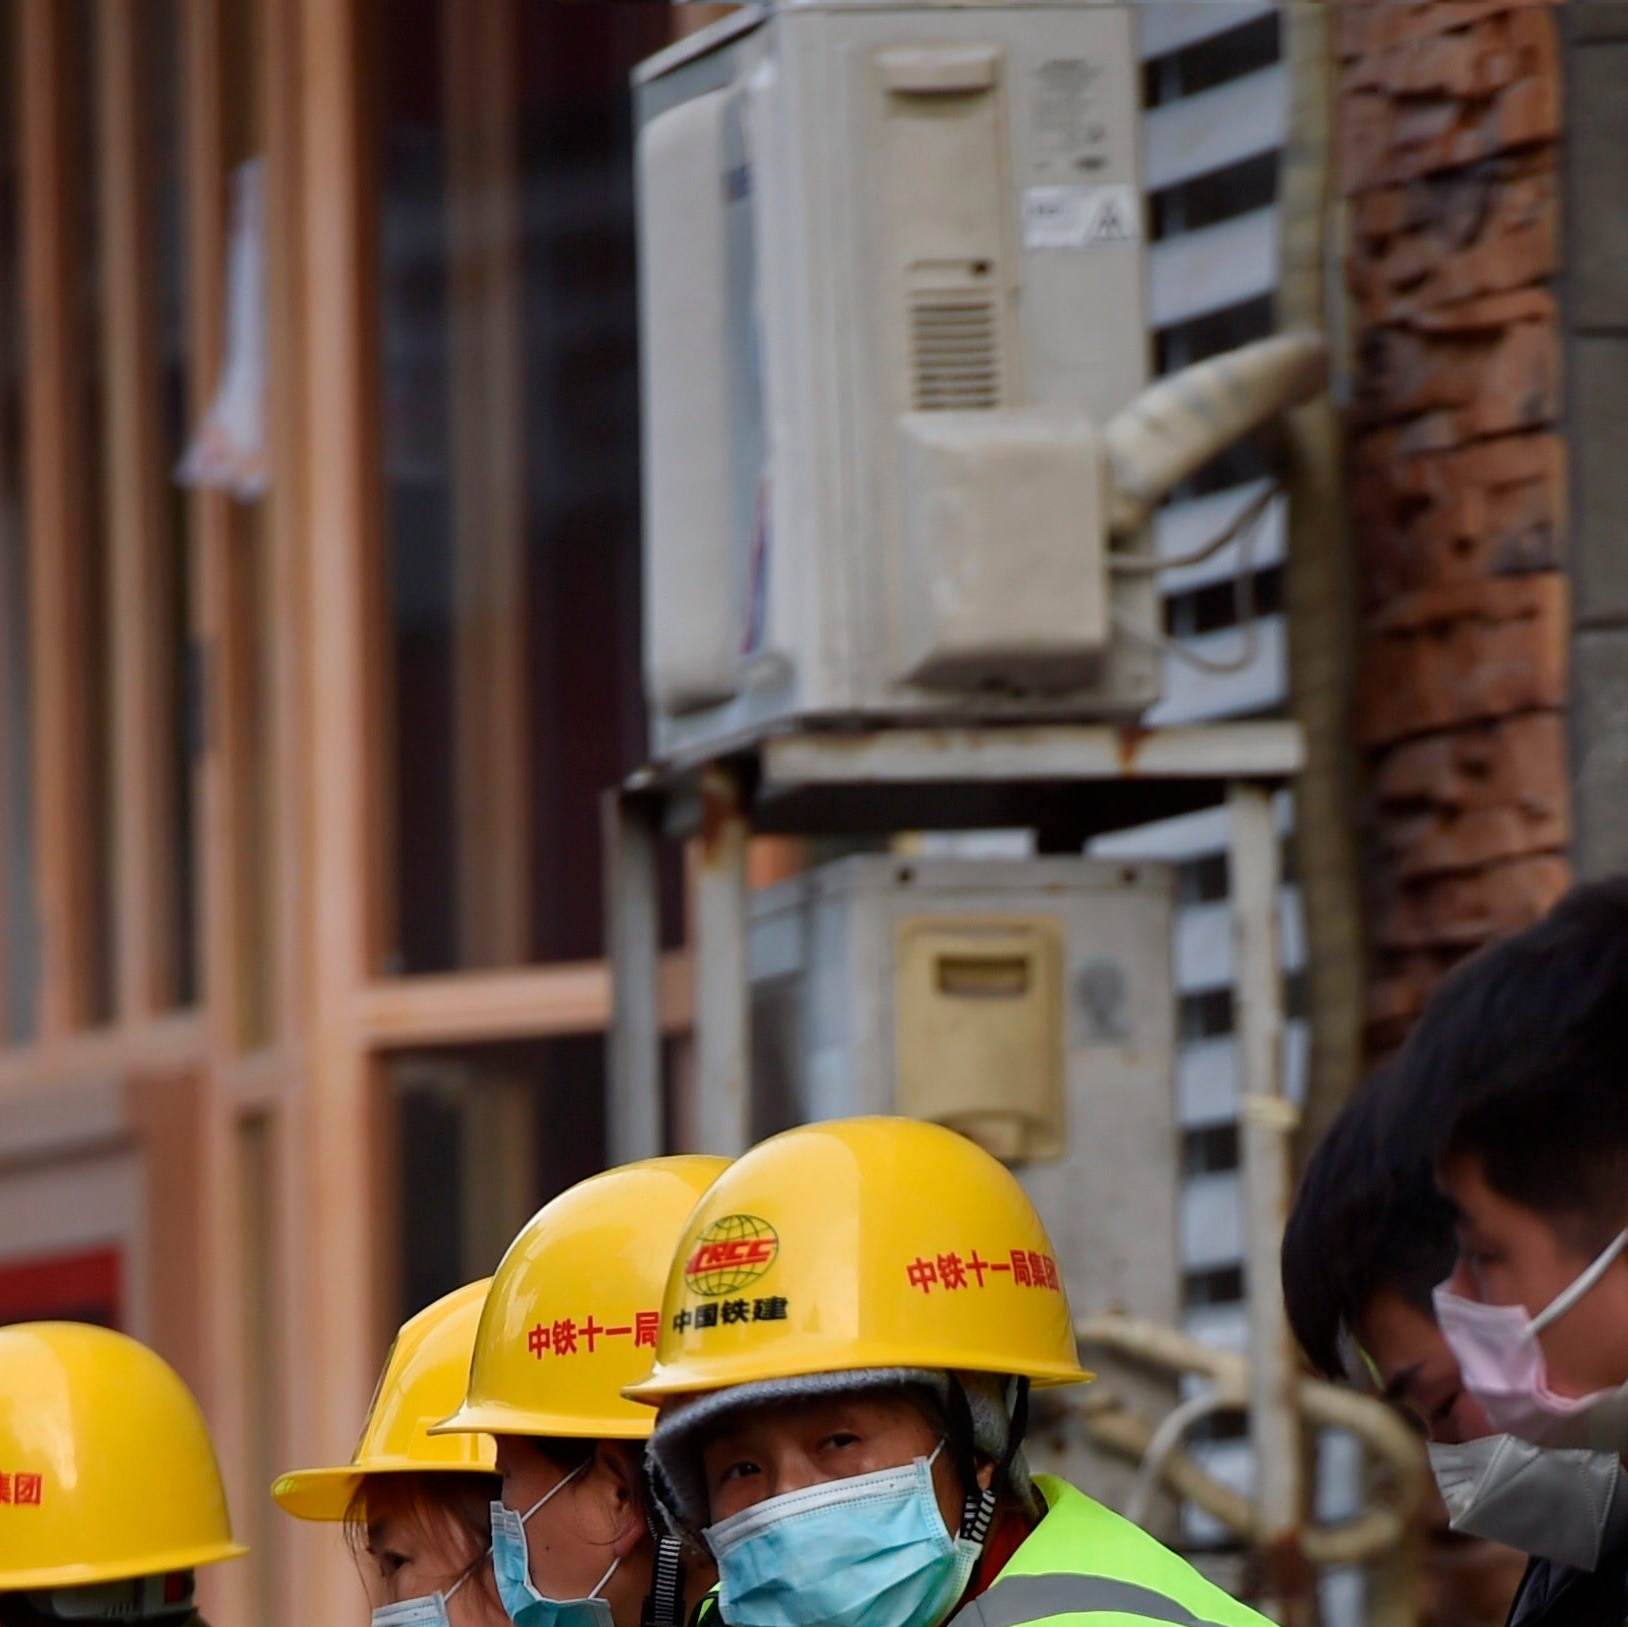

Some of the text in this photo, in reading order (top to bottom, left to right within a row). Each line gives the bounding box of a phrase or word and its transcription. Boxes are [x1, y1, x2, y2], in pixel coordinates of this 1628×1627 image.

[906, 1249, 1060, 1294] 中铁十一局集团
[528, 1311, 660, 1360] 中铁十一局
[673, 1296, 788, 1334] 中国铁建
